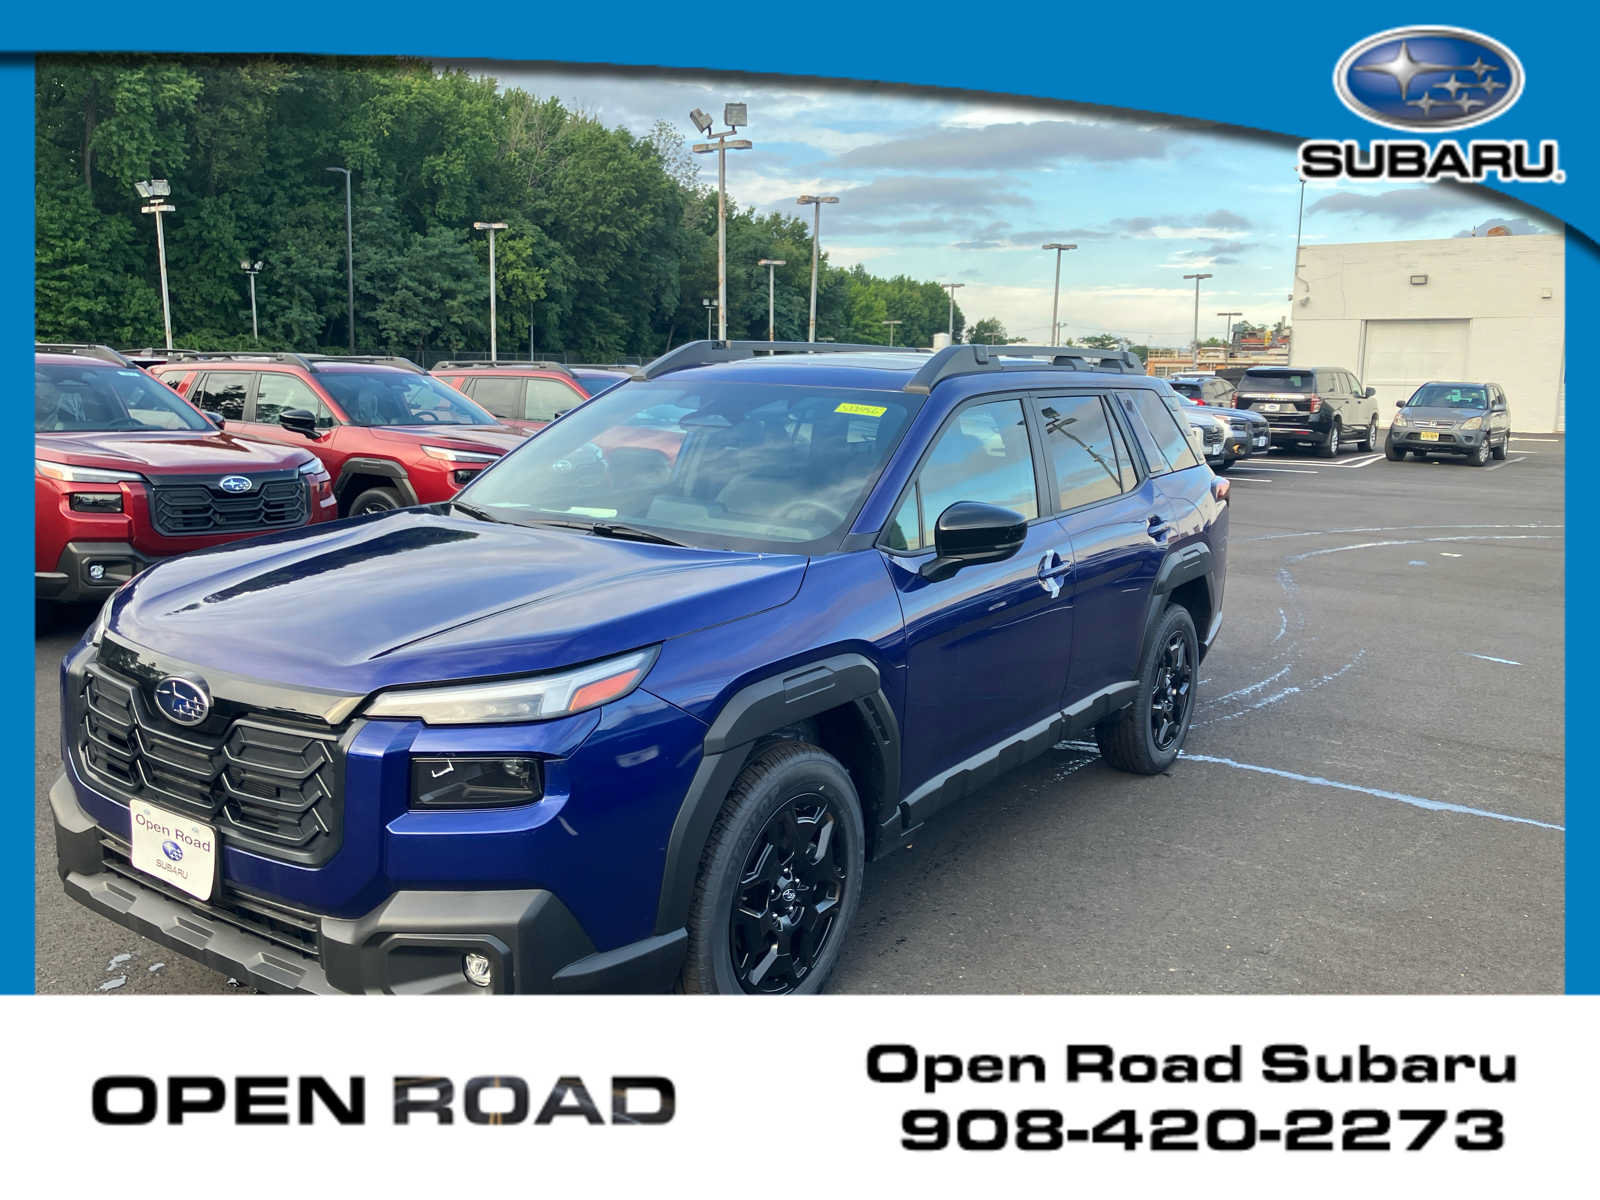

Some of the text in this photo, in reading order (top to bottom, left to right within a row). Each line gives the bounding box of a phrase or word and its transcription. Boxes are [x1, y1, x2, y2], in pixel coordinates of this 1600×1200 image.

[135, 813, 211, 853] Open Road
[155, 858, 189, 880] SUBARU
